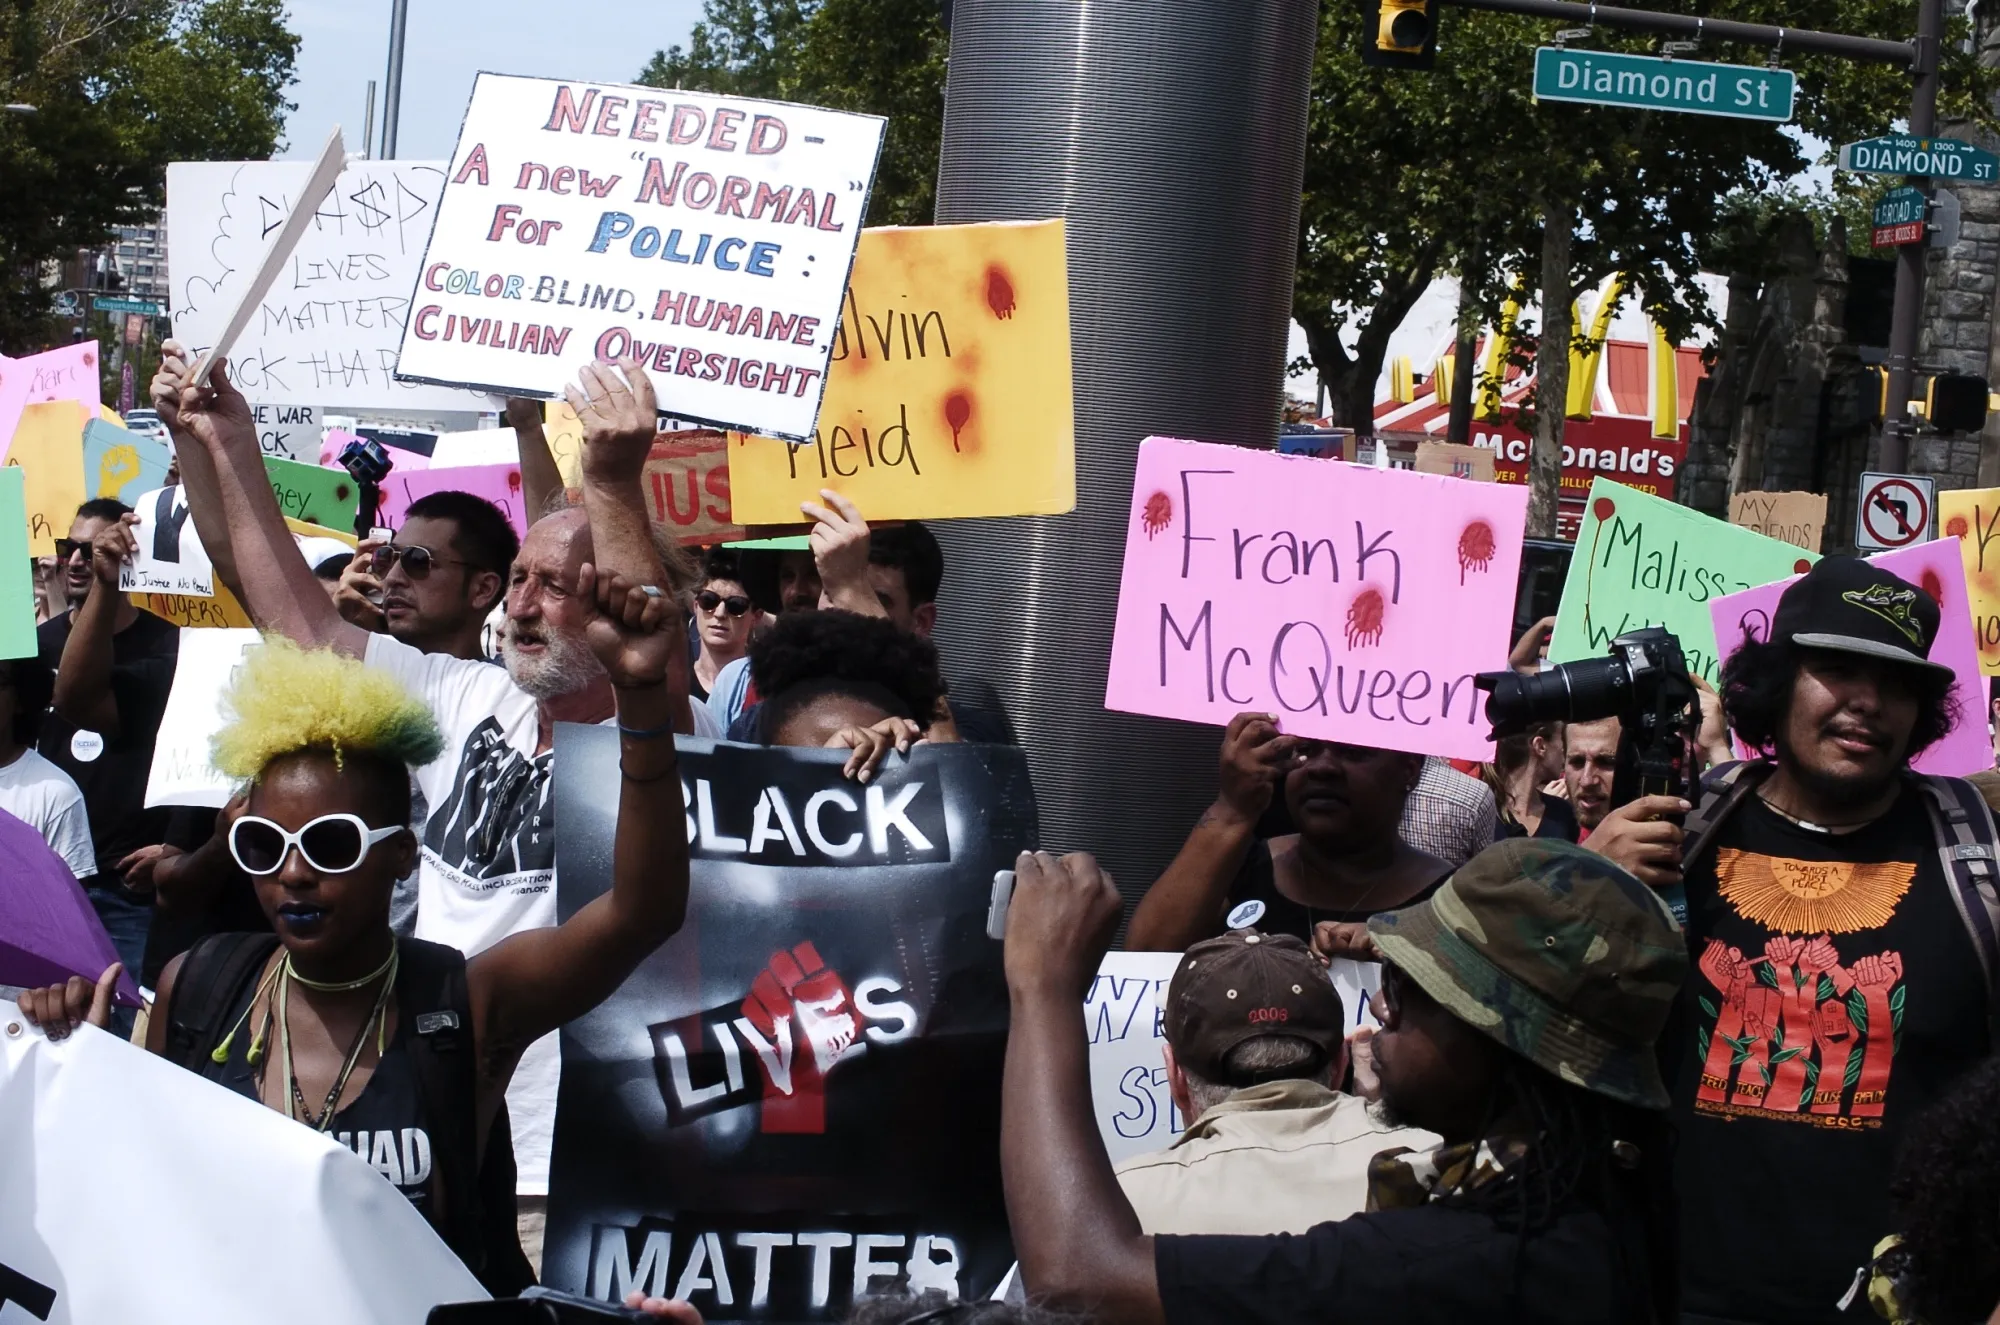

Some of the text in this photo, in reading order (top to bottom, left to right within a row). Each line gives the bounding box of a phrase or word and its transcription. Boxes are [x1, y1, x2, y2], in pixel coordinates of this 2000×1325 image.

[1558, 60, 1771, 110] Diamond St
[542, 85, 788, 156] NEEDED
[1856, 146, 1993, 179] DIAMOND ST
[1895, 139, 1955, 152] 1400 W 1300
[452, 143, 490, 186] A
[515, 161, 622, 199] new
[1881, 201, 1910, 225] BROAD
[486, 205, 562, 248] For
[585, 212, 783, 278] POLICE
[294, 253, 391, 290] LIVES
[262, 296, 409, 337] MATTER
[651, 290, 829, 355] HUMANE,
[831, 287, 951, 362] lvin
[414, 304, 822, 398] CIVILIAN OVERSIGHT
[251, 407, 314, 425] HE WAR
[1473, 433, 1675, 478] Mconald's
[1494, 470, 1517, 483] VER
[1738, 498, 1777, 522] MY
[1180, 469, 1401, 605] Frank
[1739, 523, 1811, 550] IENDS
[1603, 516, 1751, 603] Maliss
[121, 571, 136, 589] No
[138, 570, 171, 589] Justice
[177, 576, 190, 589] No
[1160, 600, 1479, 725] McQueen
[1783, 862, 1839, 876] TOWARDS A
[1791, 878, 1828, 891] PEACE
[1800, 872, 1828, 885] JUST
[663, 976, 918, 1108] LIVES
[1701, 1073, 1727, 1091] FEED
[1736, 1081, 1765, 1100] TEACH
[1813, 1090, 1842, 1104] HOUSE
[1853, 1089, 1886, 1105] EMPLOY
[323, 1127, 432, 1185] UAD
[599, 1227, 960, 1307] MATTER
